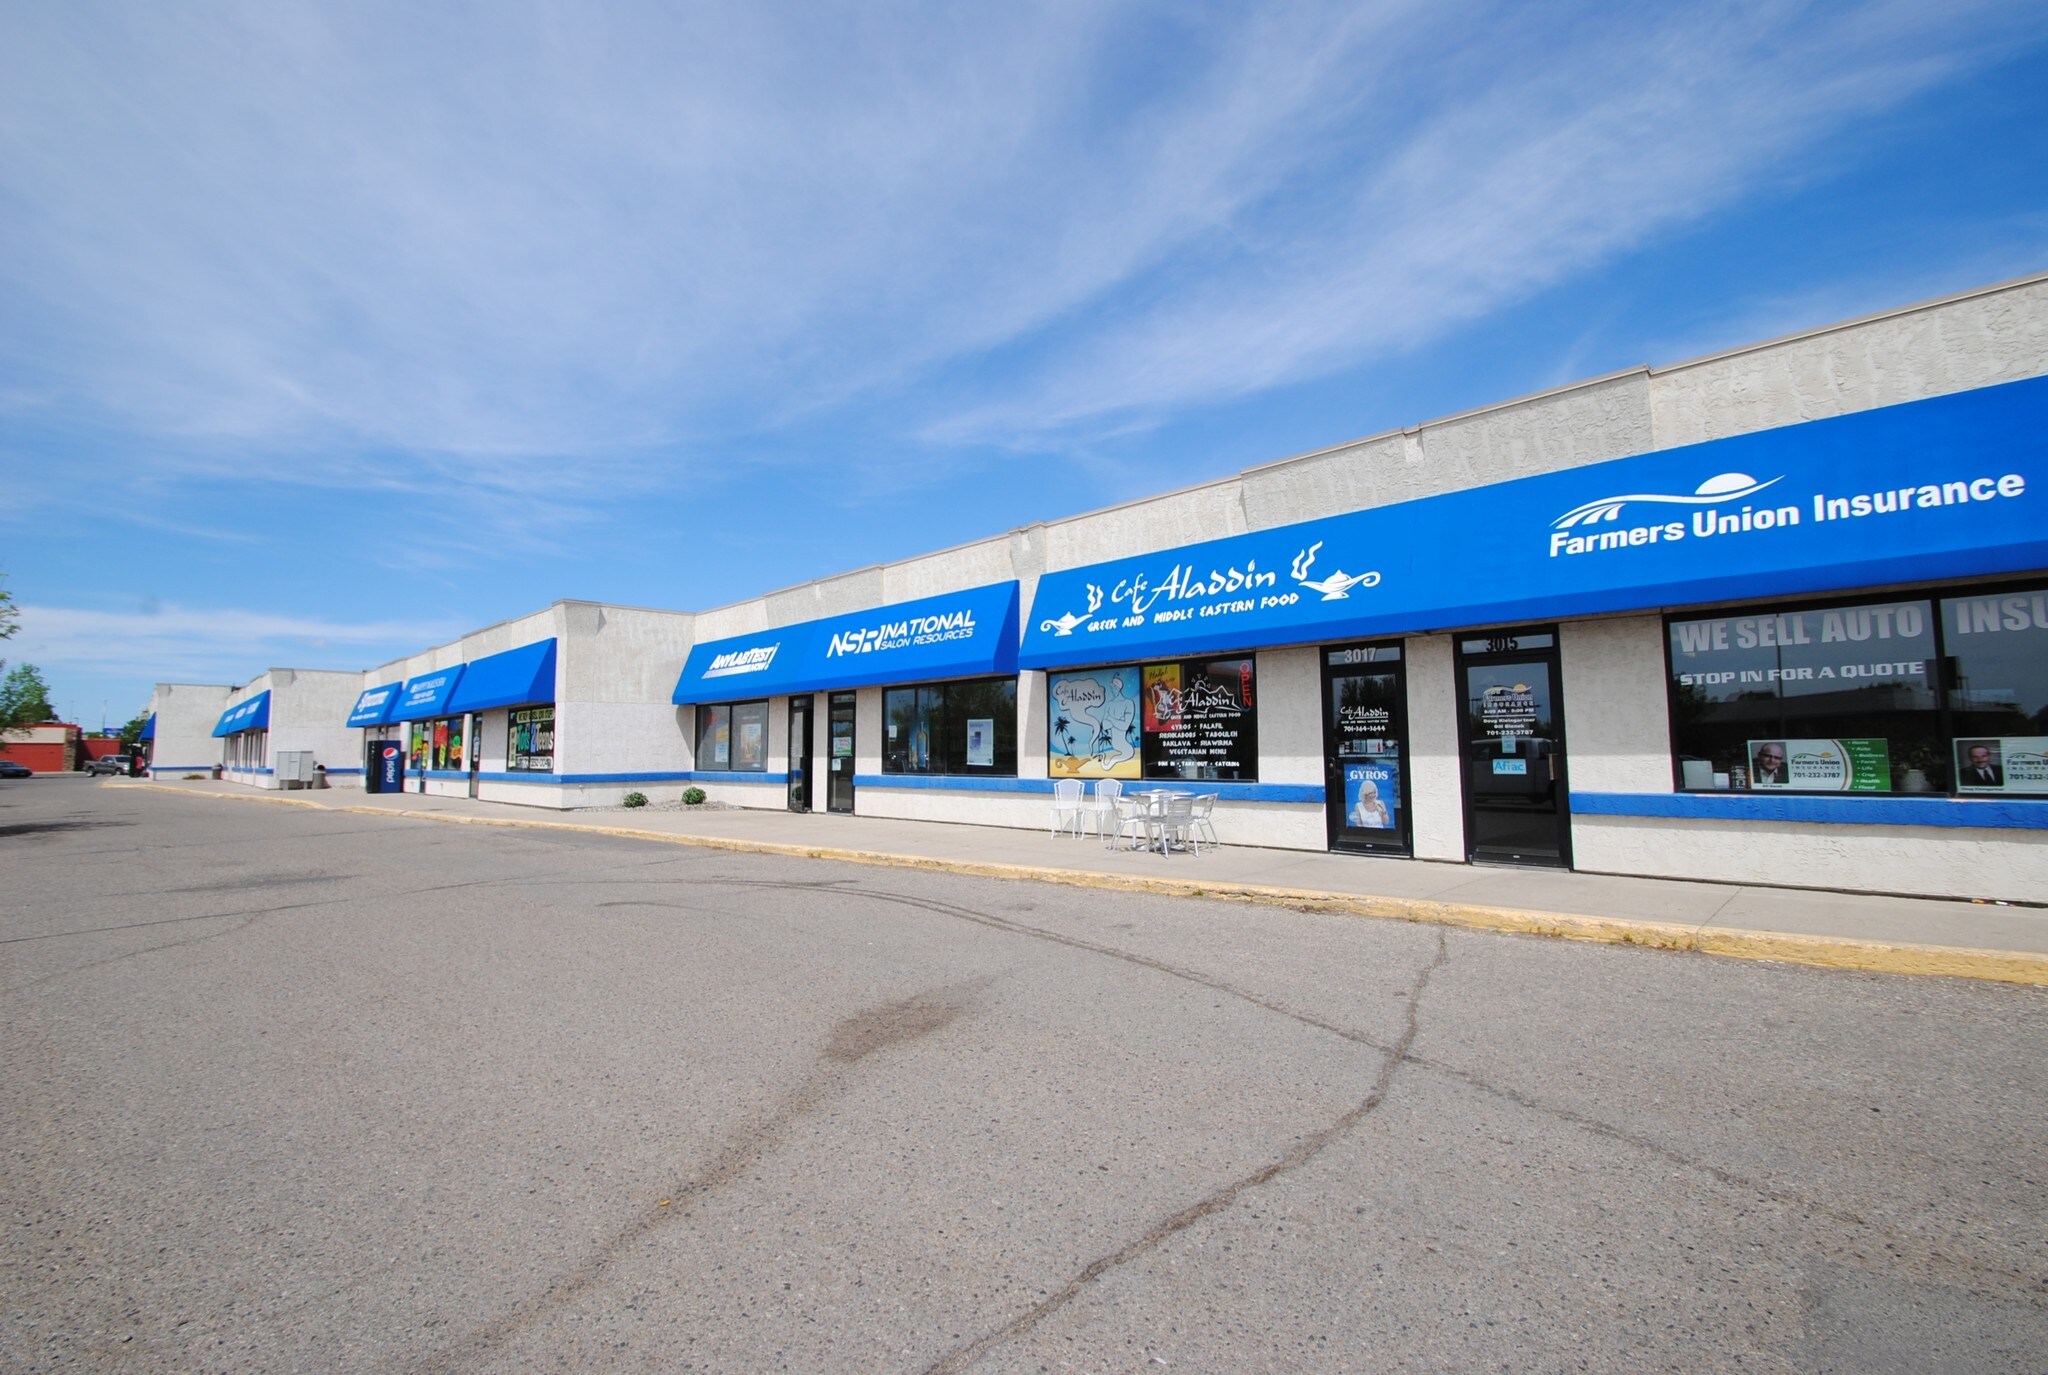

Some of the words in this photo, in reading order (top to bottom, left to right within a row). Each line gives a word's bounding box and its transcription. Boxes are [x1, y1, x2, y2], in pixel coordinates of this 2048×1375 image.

[1549, 521, 1686, 557] Farmers
[1692, 505, 1799, 538] Union
[1813, 473, 2025, 522] Insurance
[1111, 573, 1149, 605] Cafe
[1132, 558, 1276, 615] Aladdin
[1087, 618, 1118, 633] GREEK
[1122, 614, 1145, 628] AND
[1153, 607, 1194, 624] MIDDLE
[1199, 598, 1255, 618] EASTERN
[1260, 592, 1300, 609] FOOD
[884, 609, 976, 640] NATIONAL
[1677, 622, 1730, 653] WE
[1735, 615, 1810, 649] SELL
[1821, 605, 1923, 643] AUTO
[826, 624, 887, 658] NSR
[880, 637, 911, 651] SALON
[912, 627, 974, 646] RESOURCES
[1485, 636, 1519, 652] 3015
[1344, 646, 1377, 664] 3017
[1679, 671, 1736, 686] STOP
[1739, 670, 1763, 683] IN
[1767, 667, 1814, 682] FOR
[1818, 666, 1836, 679] A
[1840, 661, 1925, 679] QUOTE
[1239, 662, 1252, 707] OPEN
[1061, 688, 1101, 706] Aladdin
[1180, 691, 1230, 711] Aladdin
[1511, 692, 1534, 701] Union
[1348, 705, 1389, 720] Aladdin
[1170, 723, 1192, 731] GYROS
[1162, 740, 1192, 748] BAKLAVA
[1168, 748, 1207, 756] VEGETARIAN
[1214, 760, 1241, 768] CATERING
[1494, 760, 1524, 771] Aflac
[1791, 758, 1819, 766] Farmers
[1819, 758, 1840, 766] Union
[2006, 758, 2042, 767] Farmers
[385, 760, 396, 784] pepsi
[1349, 769, 1389, 781] GYROS
